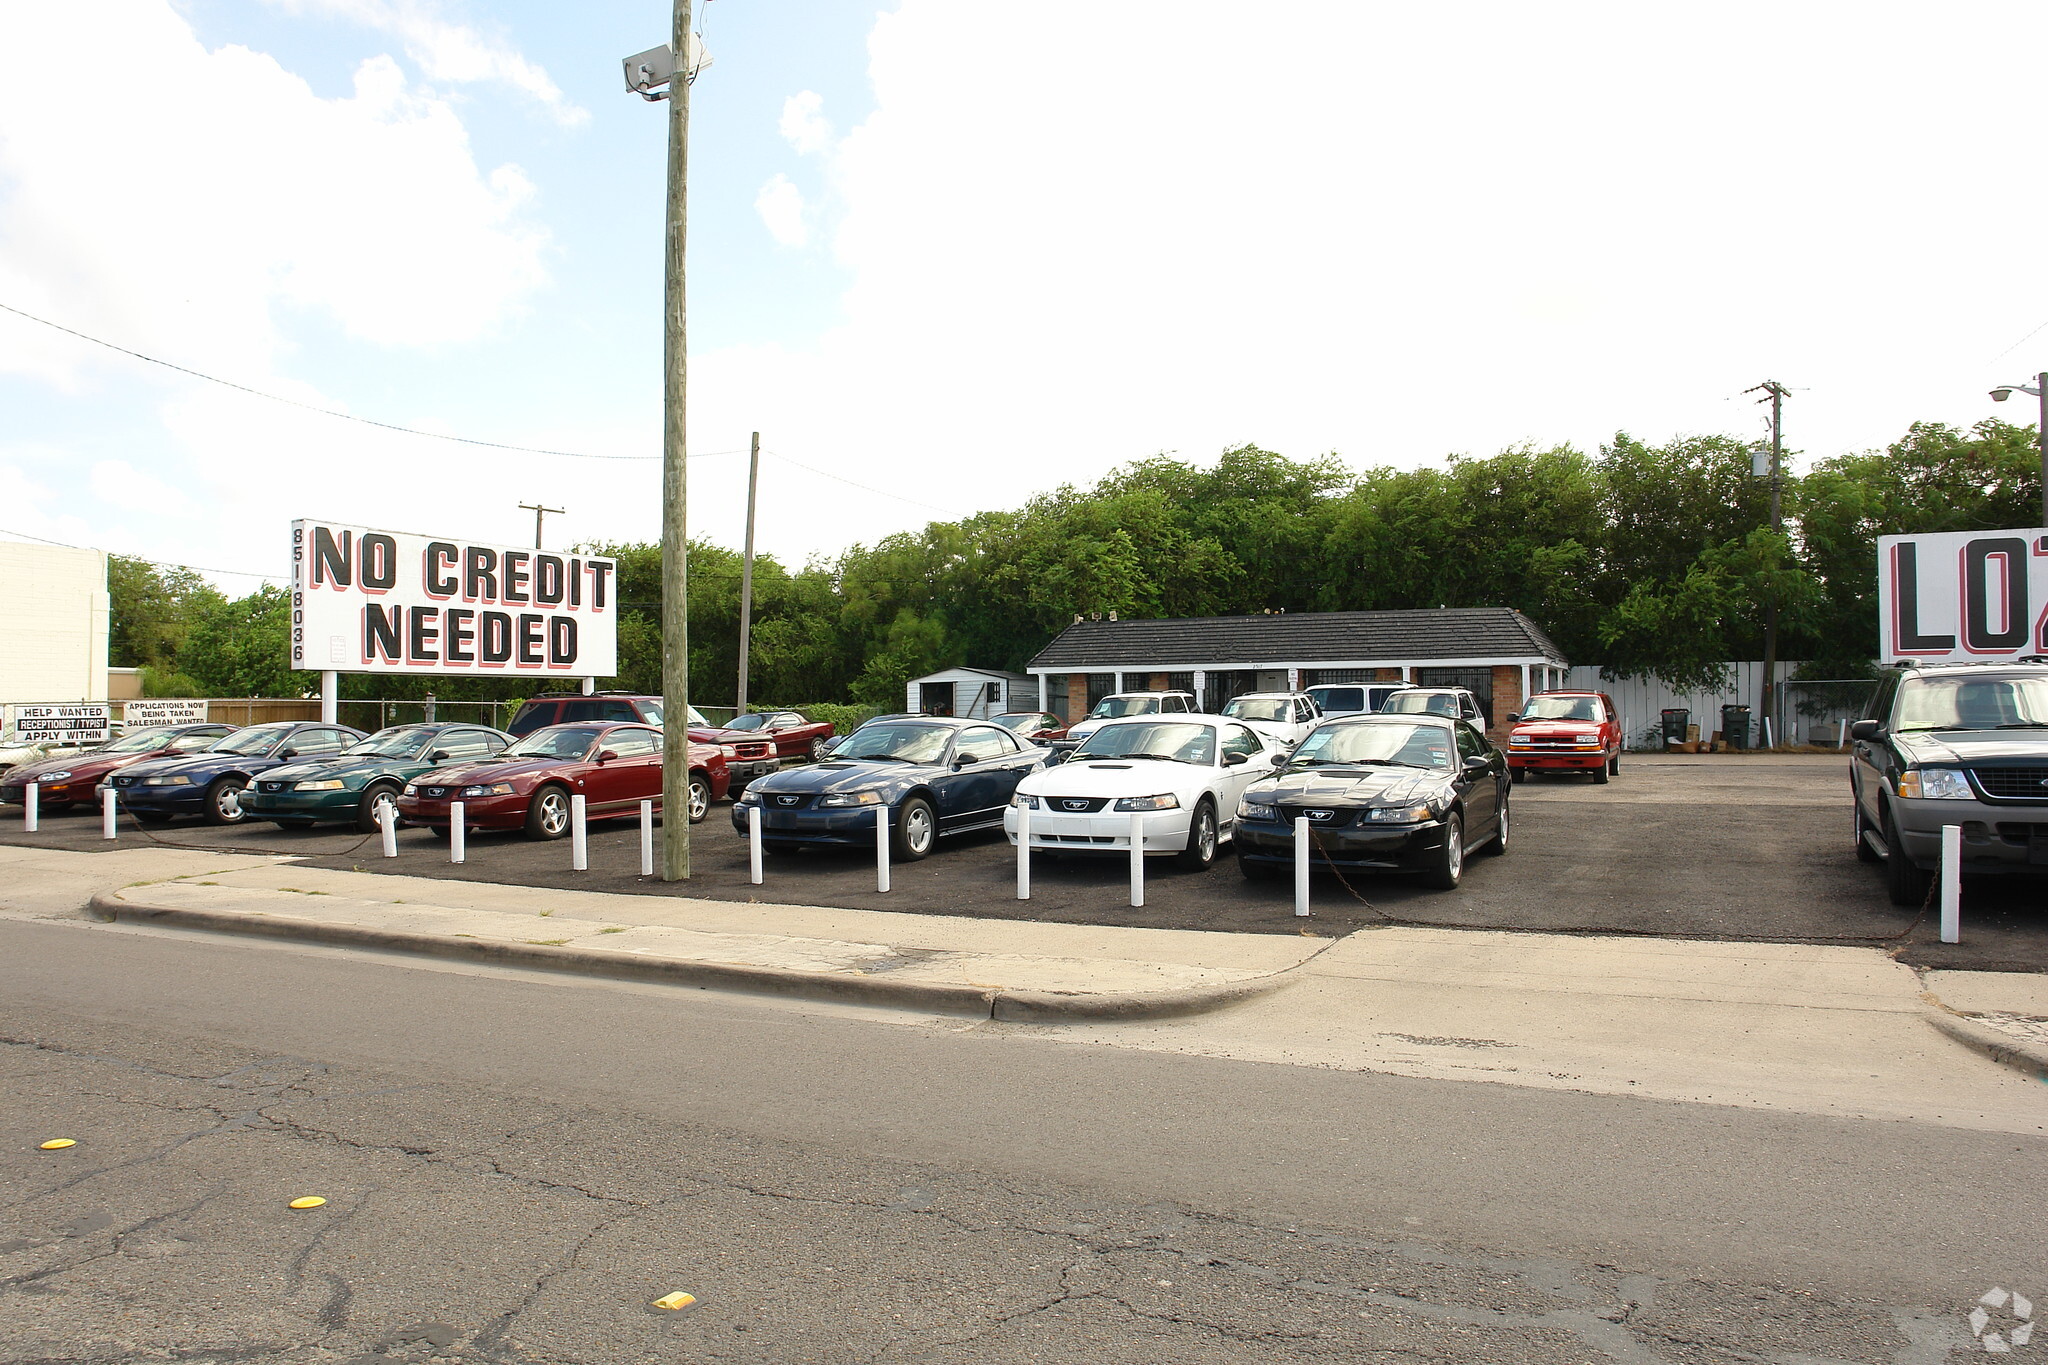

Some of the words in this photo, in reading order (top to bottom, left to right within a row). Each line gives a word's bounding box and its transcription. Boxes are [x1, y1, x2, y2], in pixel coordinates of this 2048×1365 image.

[309, 526, 396, 596] NO
[422, 541, 613, 613] CREDIT
[1890, 536, 2048, 656] LO
[361, 603, 578, 669] NEEDED
[129, 702, 185, 710] APPLICATIONS
[24, 708, 53, 717] HELP
[58, 707, 103, 717] WANTED
[141, 710, 166, 718] BEING
[127, 719, 173, 727] SALESMAN
[24, 732, 60, 741] APPLY
[66, 730, 102, 740] WITHIN
